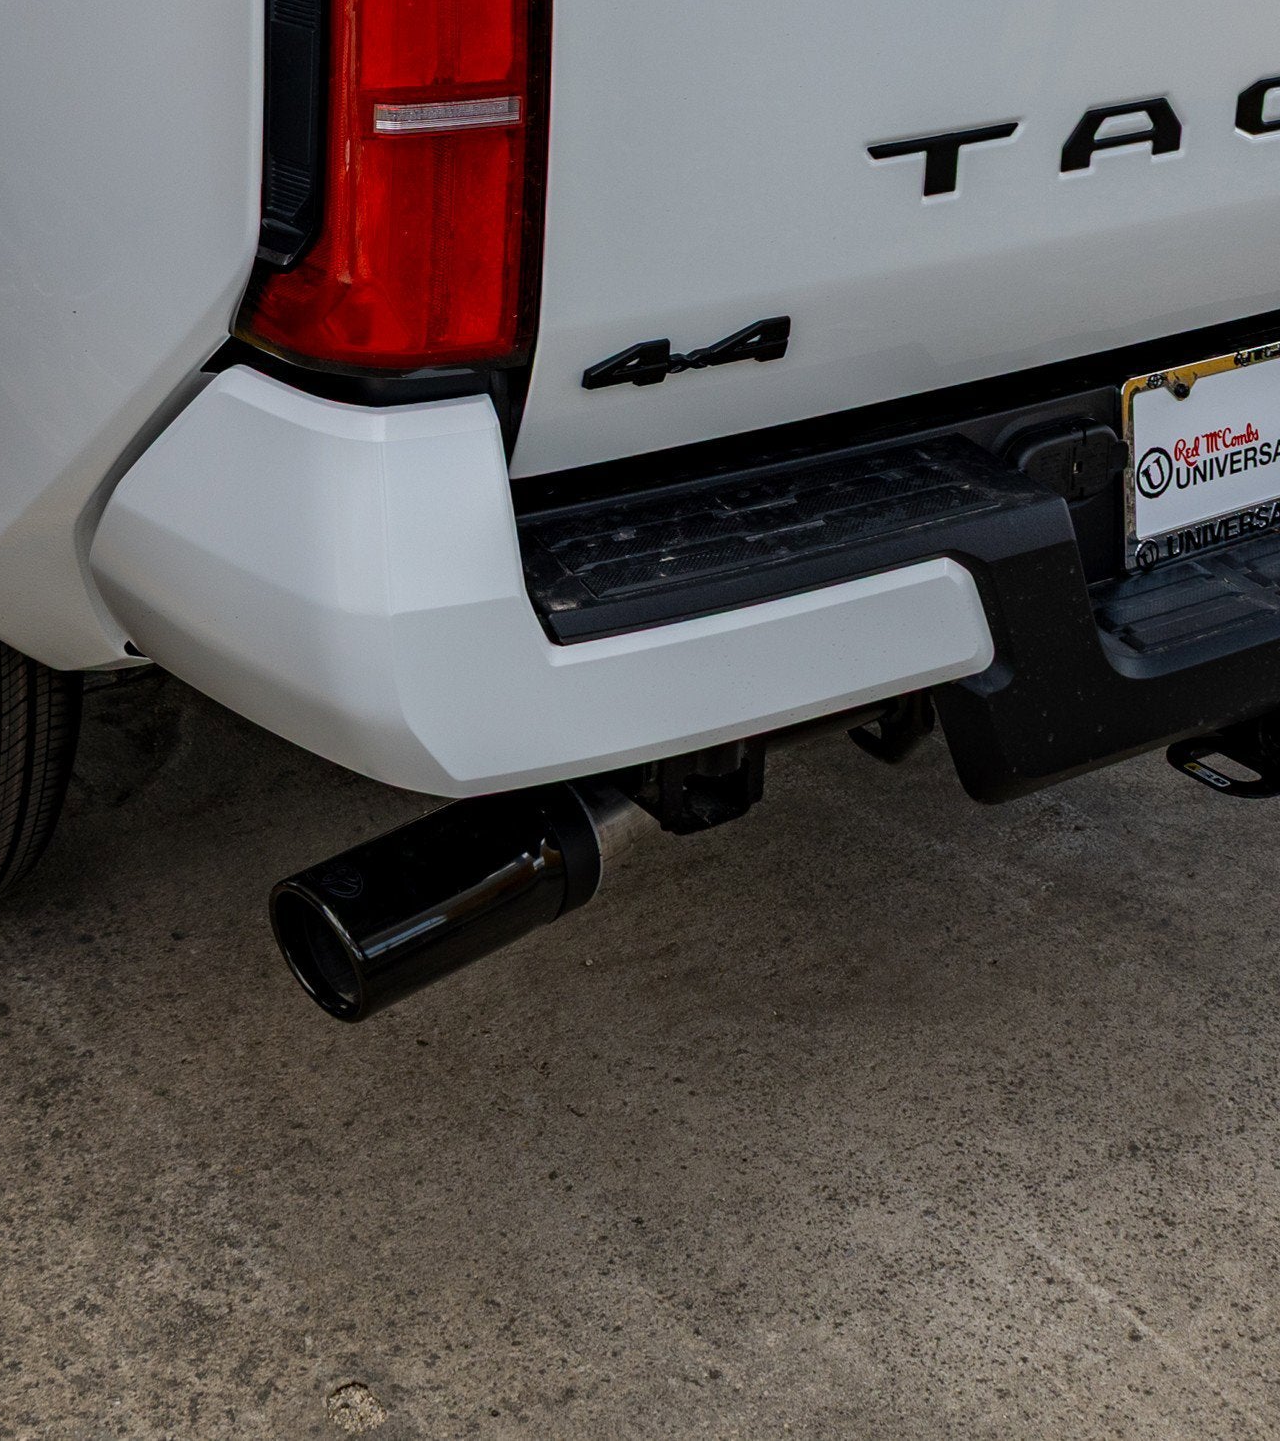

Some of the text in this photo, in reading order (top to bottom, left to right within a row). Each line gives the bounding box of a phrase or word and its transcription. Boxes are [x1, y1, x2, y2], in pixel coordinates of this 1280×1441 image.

[581, 315, 791, 390] 4x4
[1174, 422, 1259, 467] Red McCombs
